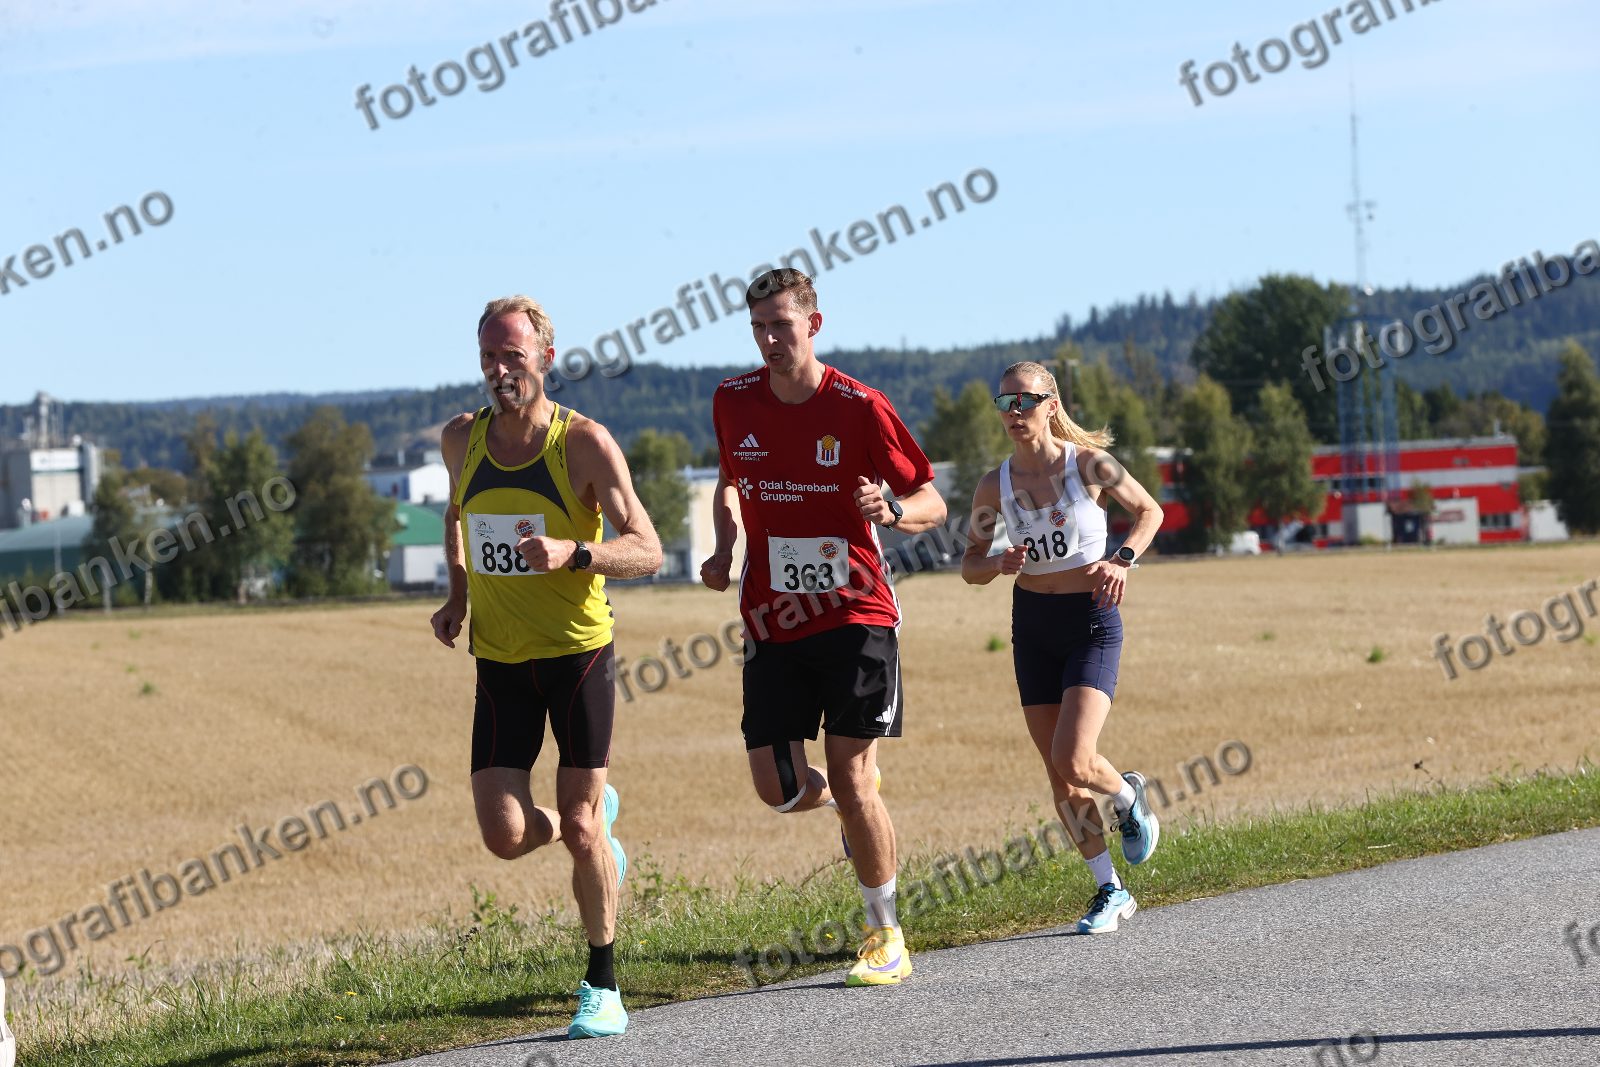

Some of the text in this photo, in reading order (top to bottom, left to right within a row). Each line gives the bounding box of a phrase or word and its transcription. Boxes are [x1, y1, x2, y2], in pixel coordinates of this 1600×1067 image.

[759, 481, 840, 493] Odal Sparebank
[760, 491, 804, 503] Gruppen
[1023, 530, 1068, 563] 818
[784, 562, 835, 592] 363
